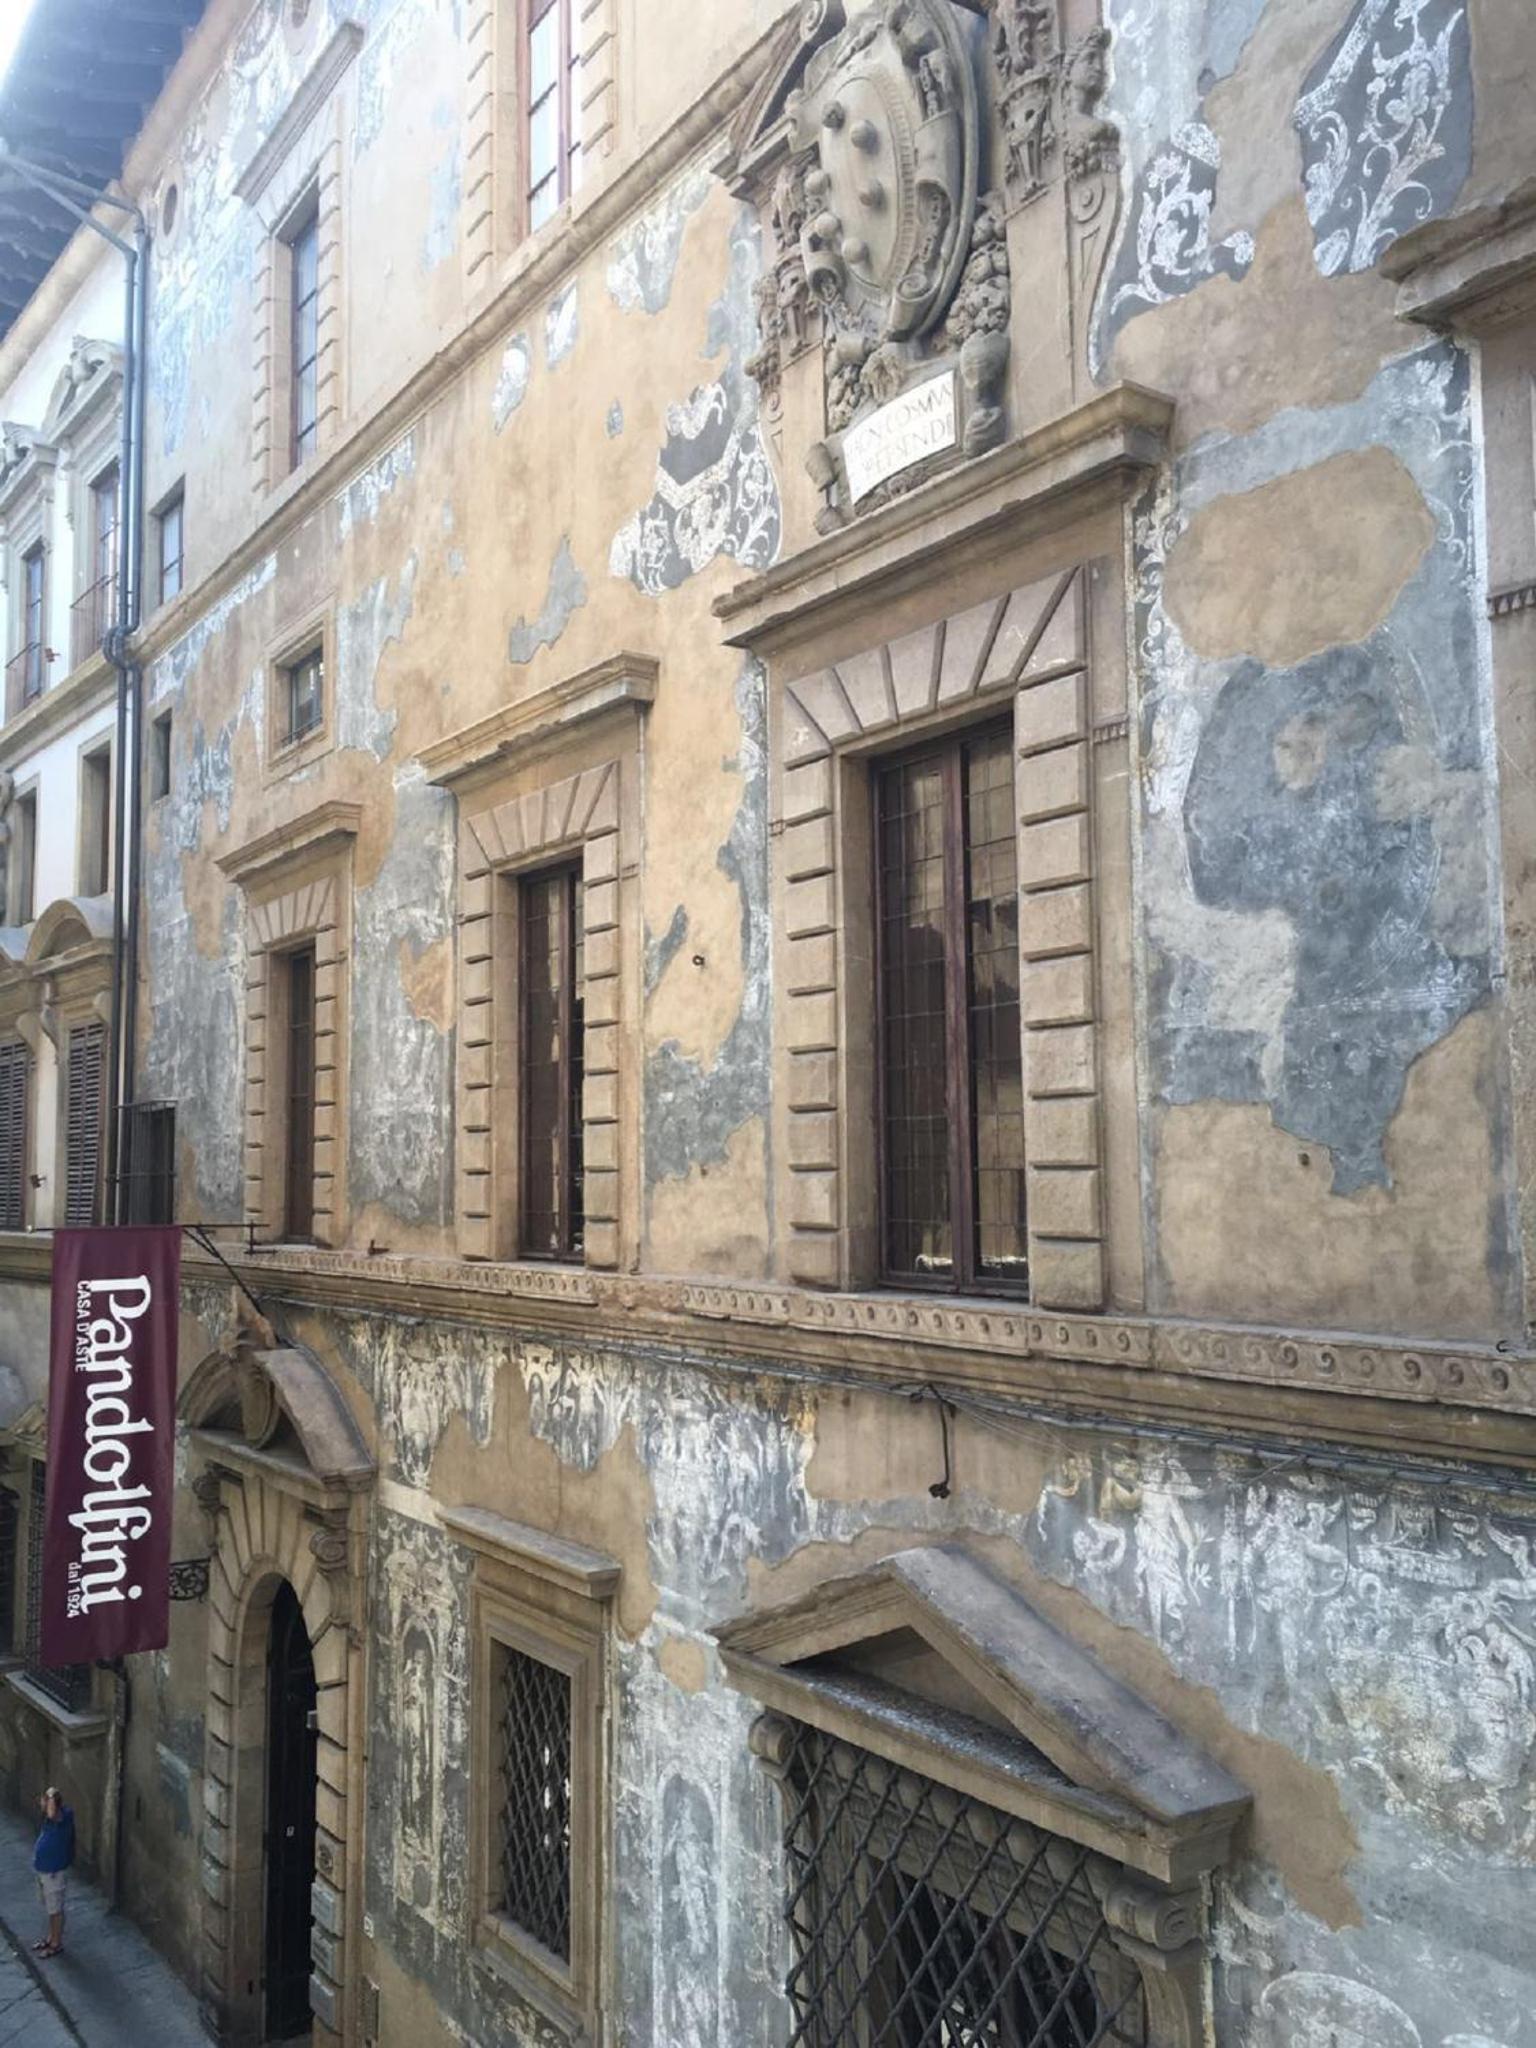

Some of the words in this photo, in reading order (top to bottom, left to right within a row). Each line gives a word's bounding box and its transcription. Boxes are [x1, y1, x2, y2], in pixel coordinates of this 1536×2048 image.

[77, 1280, 91, 1319] CASA
[75, 1321, 91, 1373] D'ASTE
[68, 1274, 155, 1615] Pandolfini
[68, 1561, 82, 1583] dal
[67, 1586, 80, 1618] 1924
